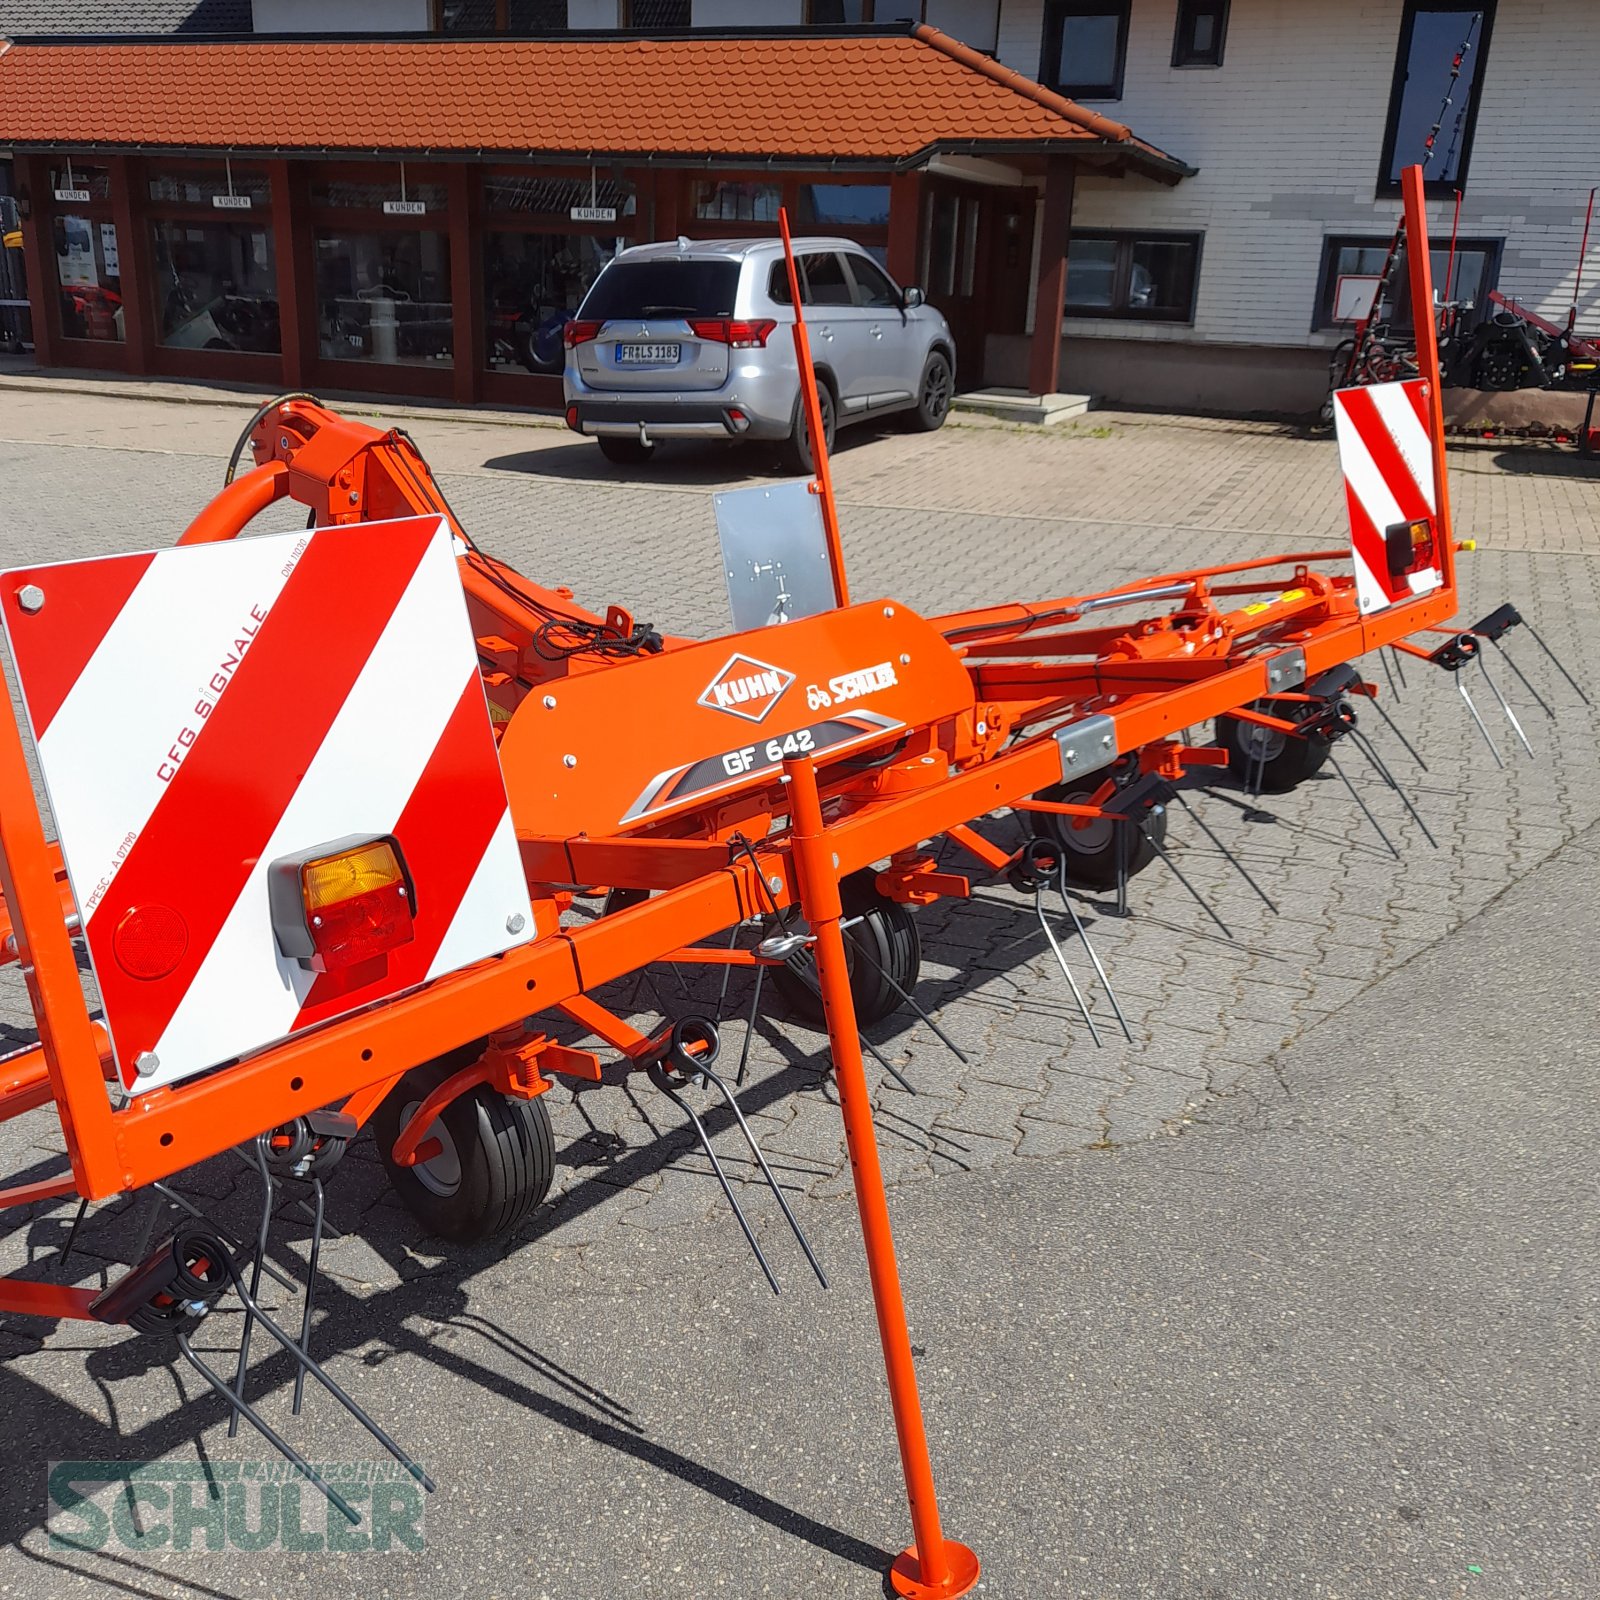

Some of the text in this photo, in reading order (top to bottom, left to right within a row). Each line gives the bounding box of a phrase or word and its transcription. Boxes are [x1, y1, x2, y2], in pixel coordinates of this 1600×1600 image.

[59, 191, 88, 200] KUNDEN
[218, 197, 249, 207] KUNDEN
[389, 202, 423, 213] KUNDEN
[576, 208, 614, 219] KUNDEN
[622, 345, 678, 359] FR LS 1183
[281, 538, 308, 578] DIN 11030
[713, 670, 783, 708] KUHN
[828, 661, 898, 704] SCHULER
[156, 727, 197, 783] CFG
[722, 729, 815, 777] GF 642
[85, 877, 110, 910] TPESC
[111, 860, 121, 869] A
[116, 831, 137, 859] 07190
